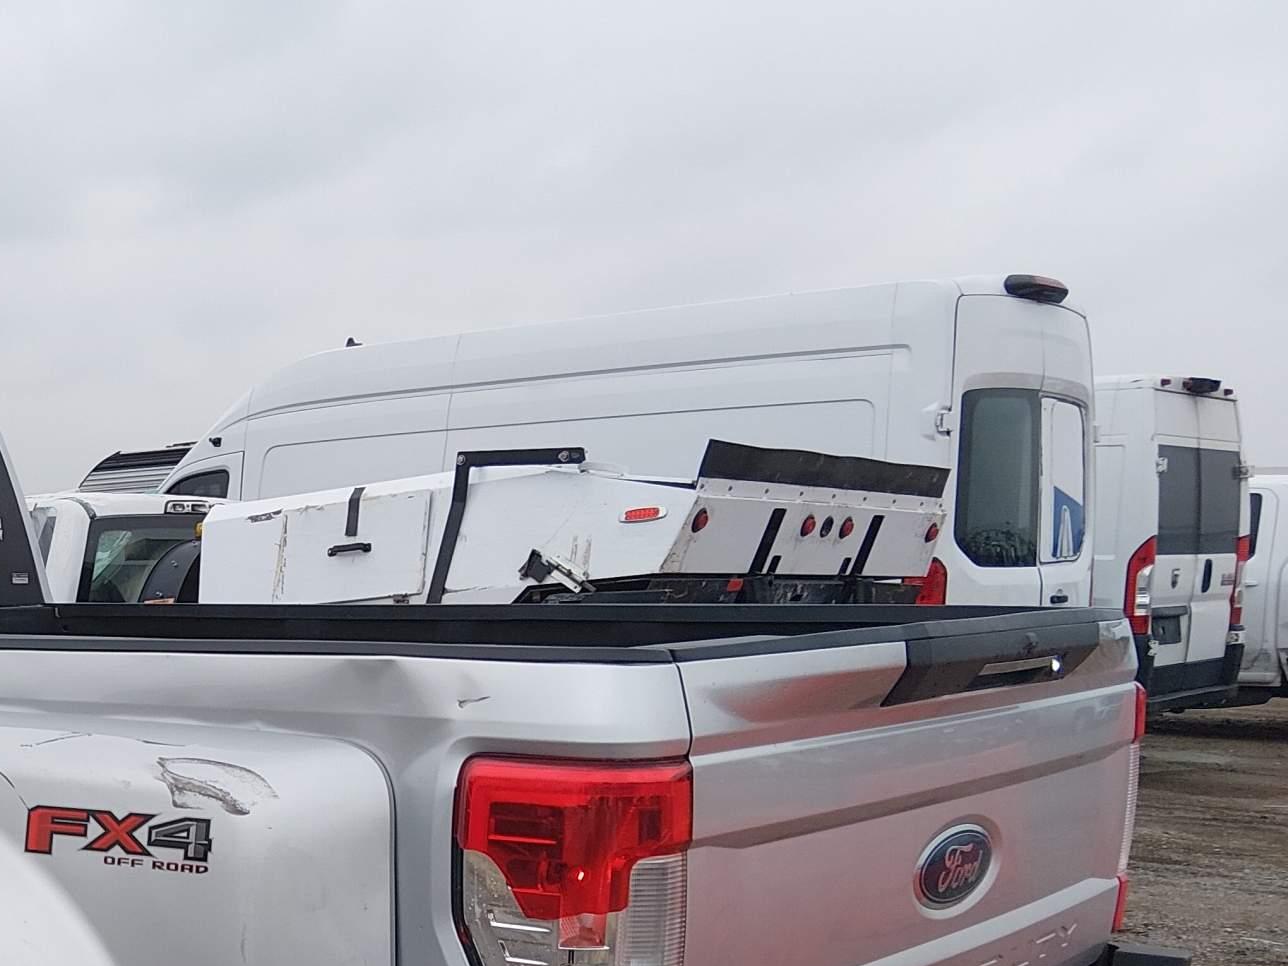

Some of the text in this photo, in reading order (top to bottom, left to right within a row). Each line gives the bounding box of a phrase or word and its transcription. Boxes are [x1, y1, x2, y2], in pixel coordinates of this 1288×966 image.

[24, 805, 212, 862] FX4
[104, 856, 209, 874] OFF ROAD
[938, 844, 983, 893] Ford
